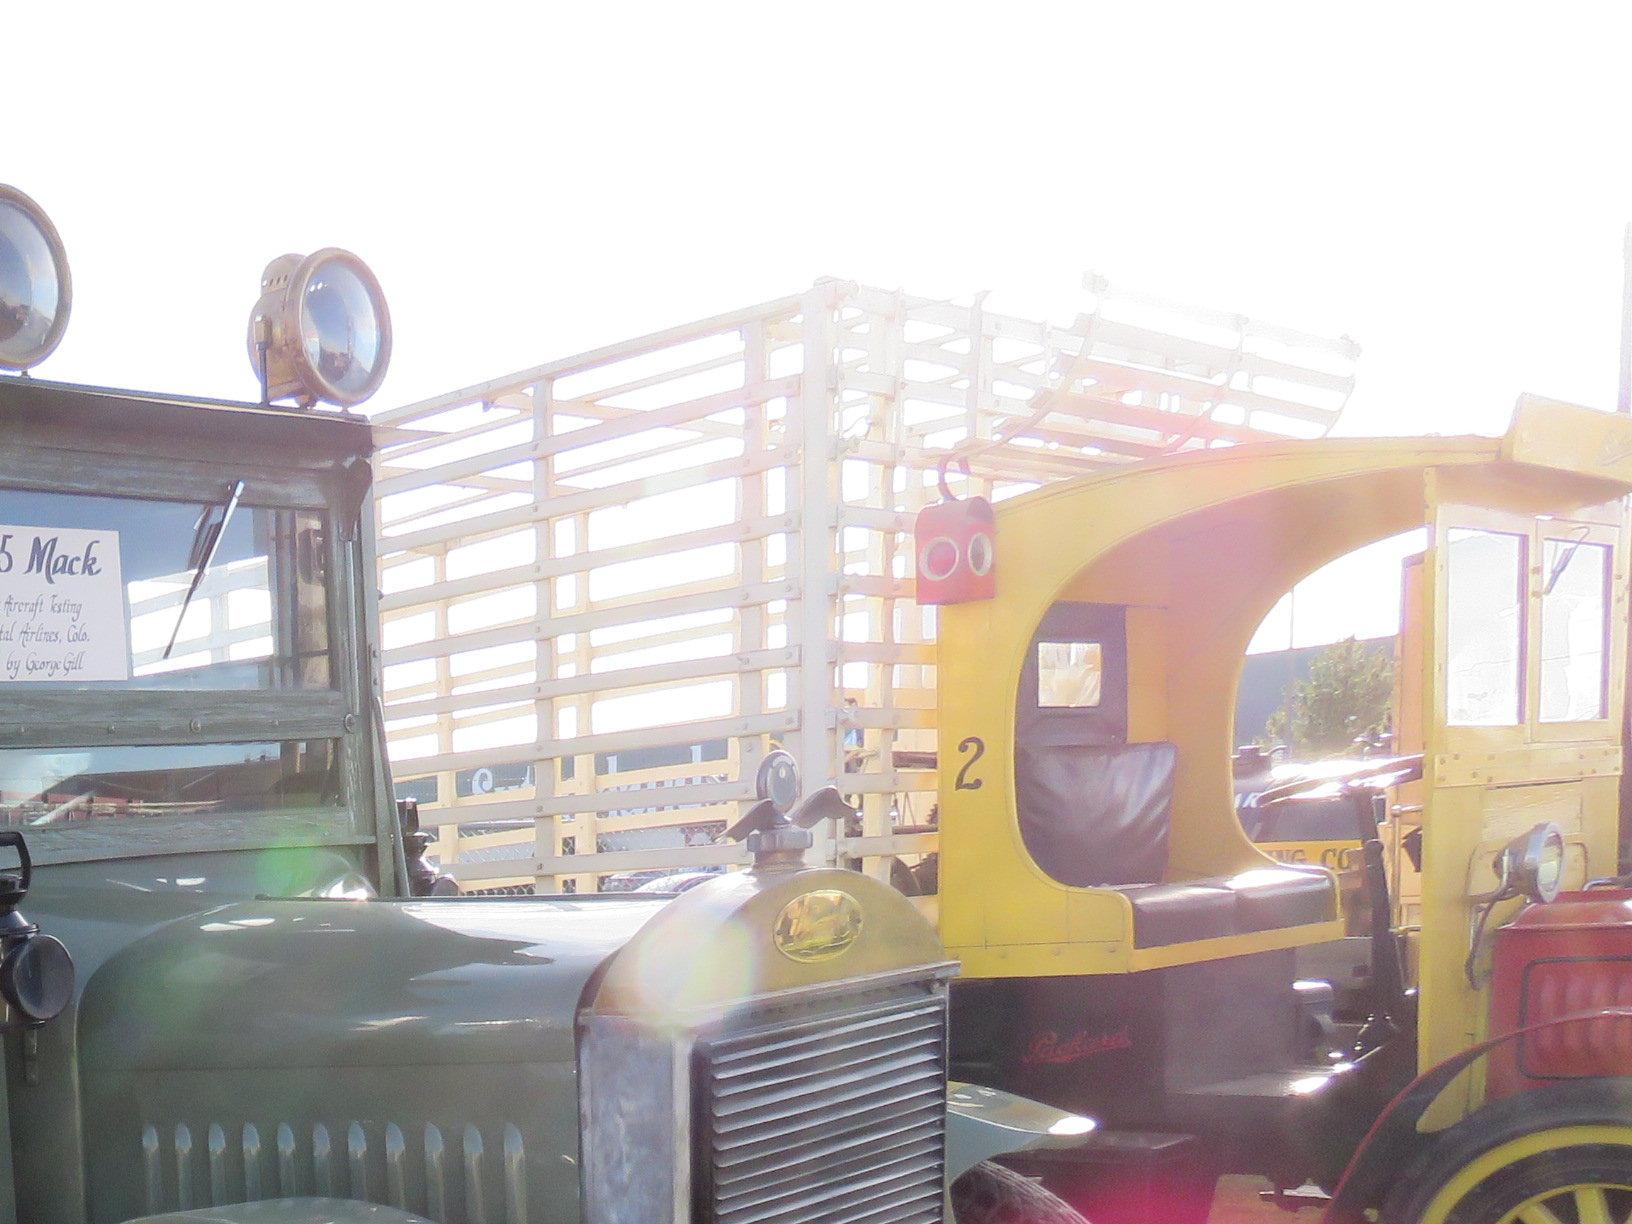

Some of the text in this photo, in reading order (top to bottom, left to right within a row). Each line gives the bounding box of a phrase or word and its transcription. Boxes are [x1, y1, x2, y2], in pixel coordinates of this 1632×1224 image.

[23, 536, 102, 585] Mack
[2, 593, 44, 622] Aircraft
[50, 594, 83, 622] Testing
[6, 650, 22, 680] by
[25, 651, 61, 677] George
[62, 650, 86, 676] Gill
[954, 735, 985, 792] 2
